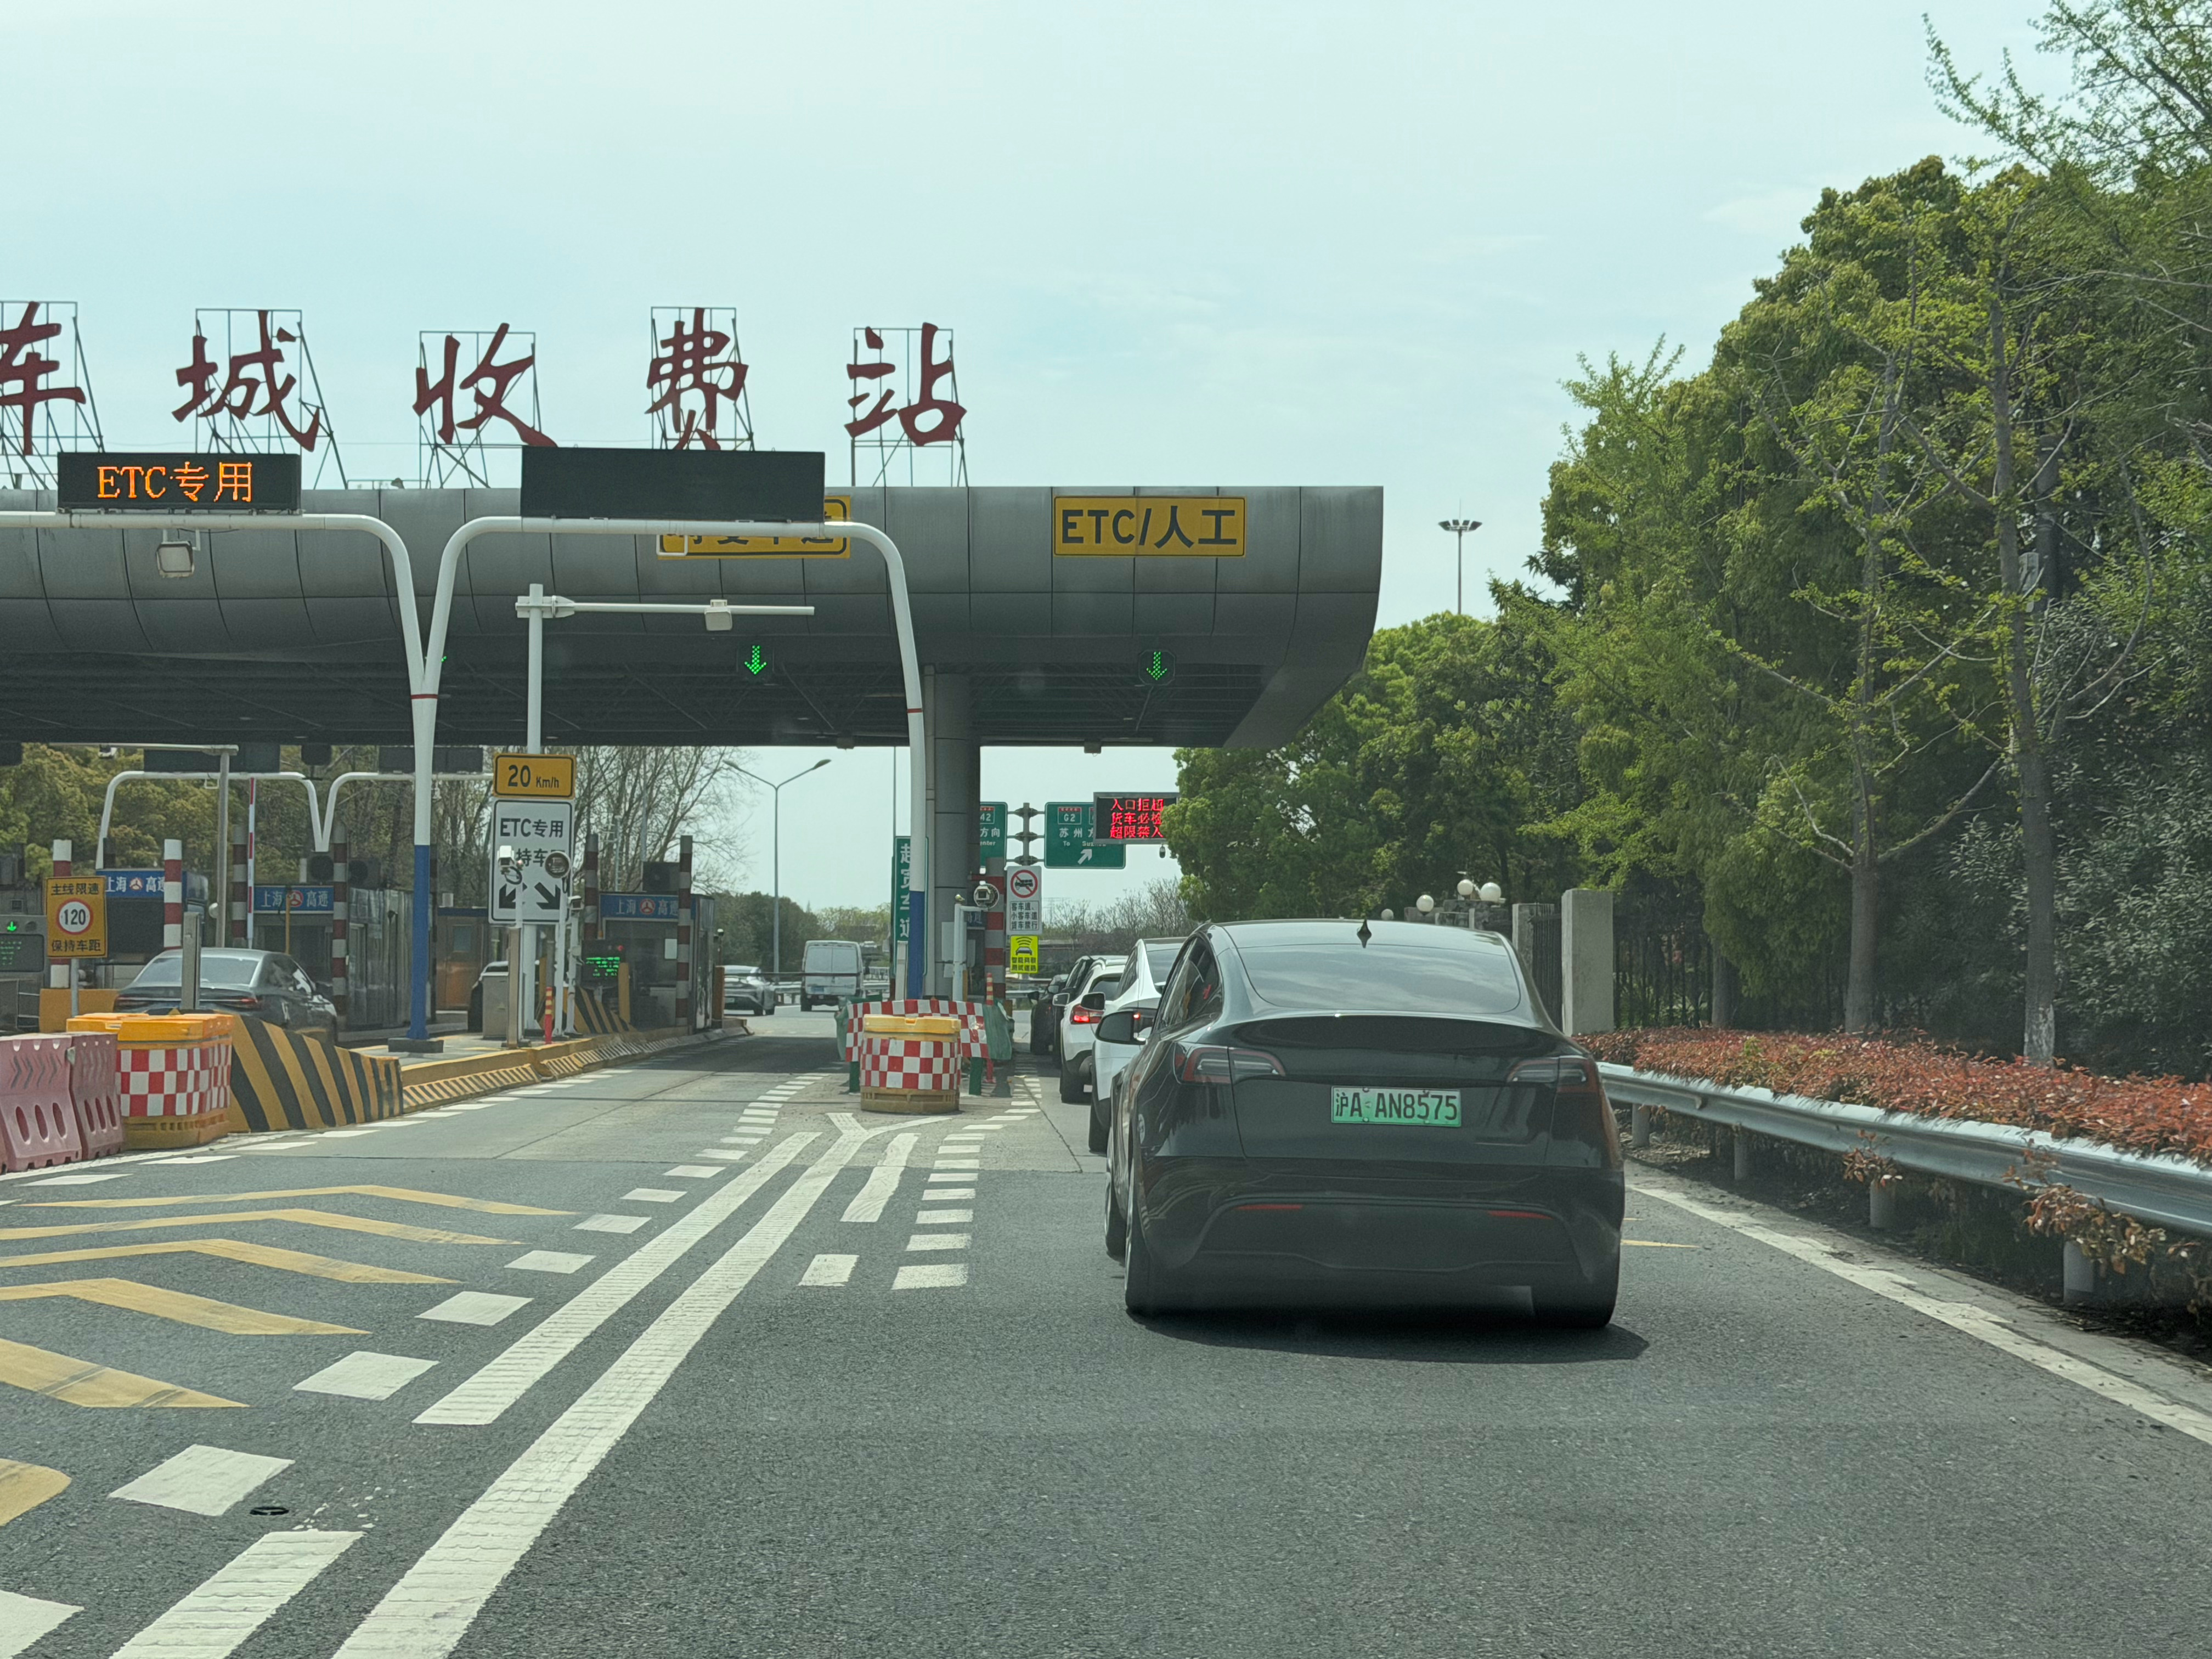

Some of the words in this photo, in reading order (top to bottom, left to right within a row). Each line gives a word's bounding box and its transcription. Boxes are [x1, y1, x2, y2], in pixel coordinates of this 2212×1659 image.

[97, 461, 252, 501] ETC专用
[1062, 505, 1237, 549] ETC/人工
[508, 765, 531, 787] 20
[536, 776, 559, 788] Km/h
[1064, 813, 1075, 822] G2
[500, 818, 563, 838] ETC专用
[1110, 825, 1164, 839] 超限禁入
[51, 883, 99, 895] 主线限速
[307, 890, 329, 907] 高速
[64, 909, 86, 925] 120
[52, 939, 101, 952] 保持车距
[1374, 1092, 1457, 1120] AN8575
